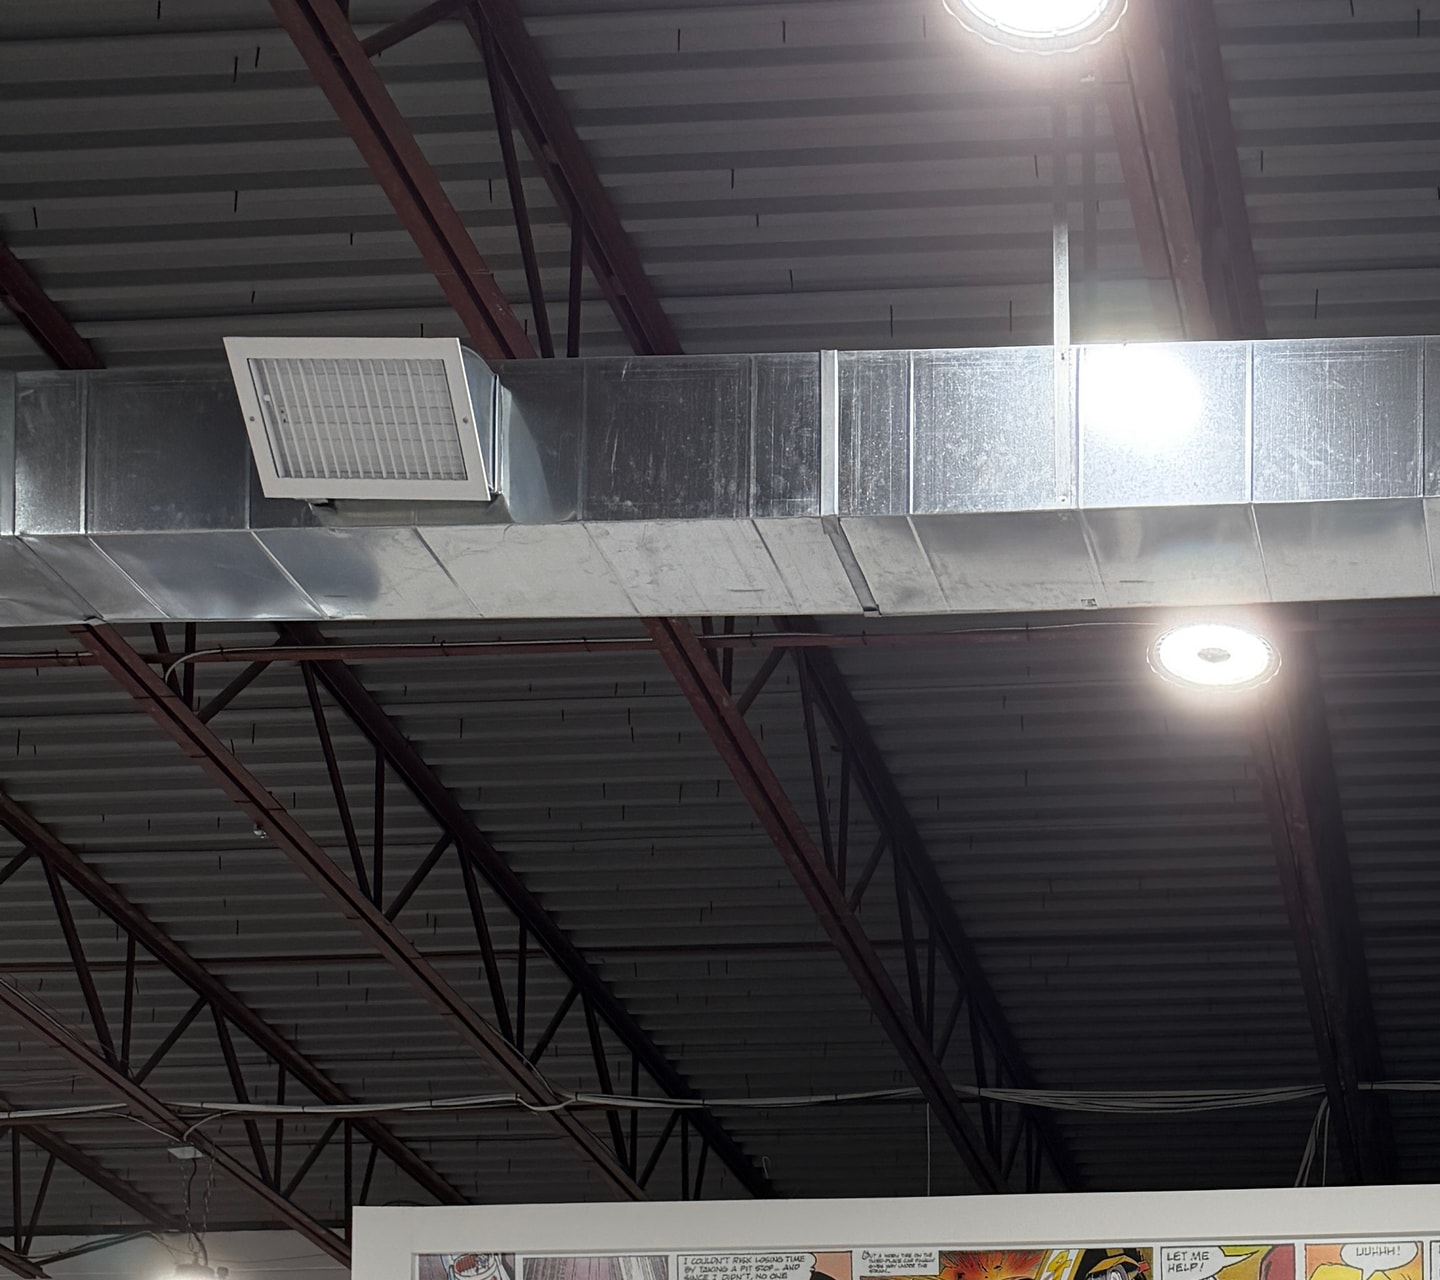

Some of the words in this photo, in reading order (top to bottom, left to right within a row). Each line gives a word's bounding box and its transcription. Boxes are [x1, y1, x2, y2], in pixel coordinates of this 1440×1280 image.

[1167, 1250, 1188, 1261] LET
[1190, 1251, 1210, 1261] ME
[1168, 1262, 1204, 1272] HELP!
